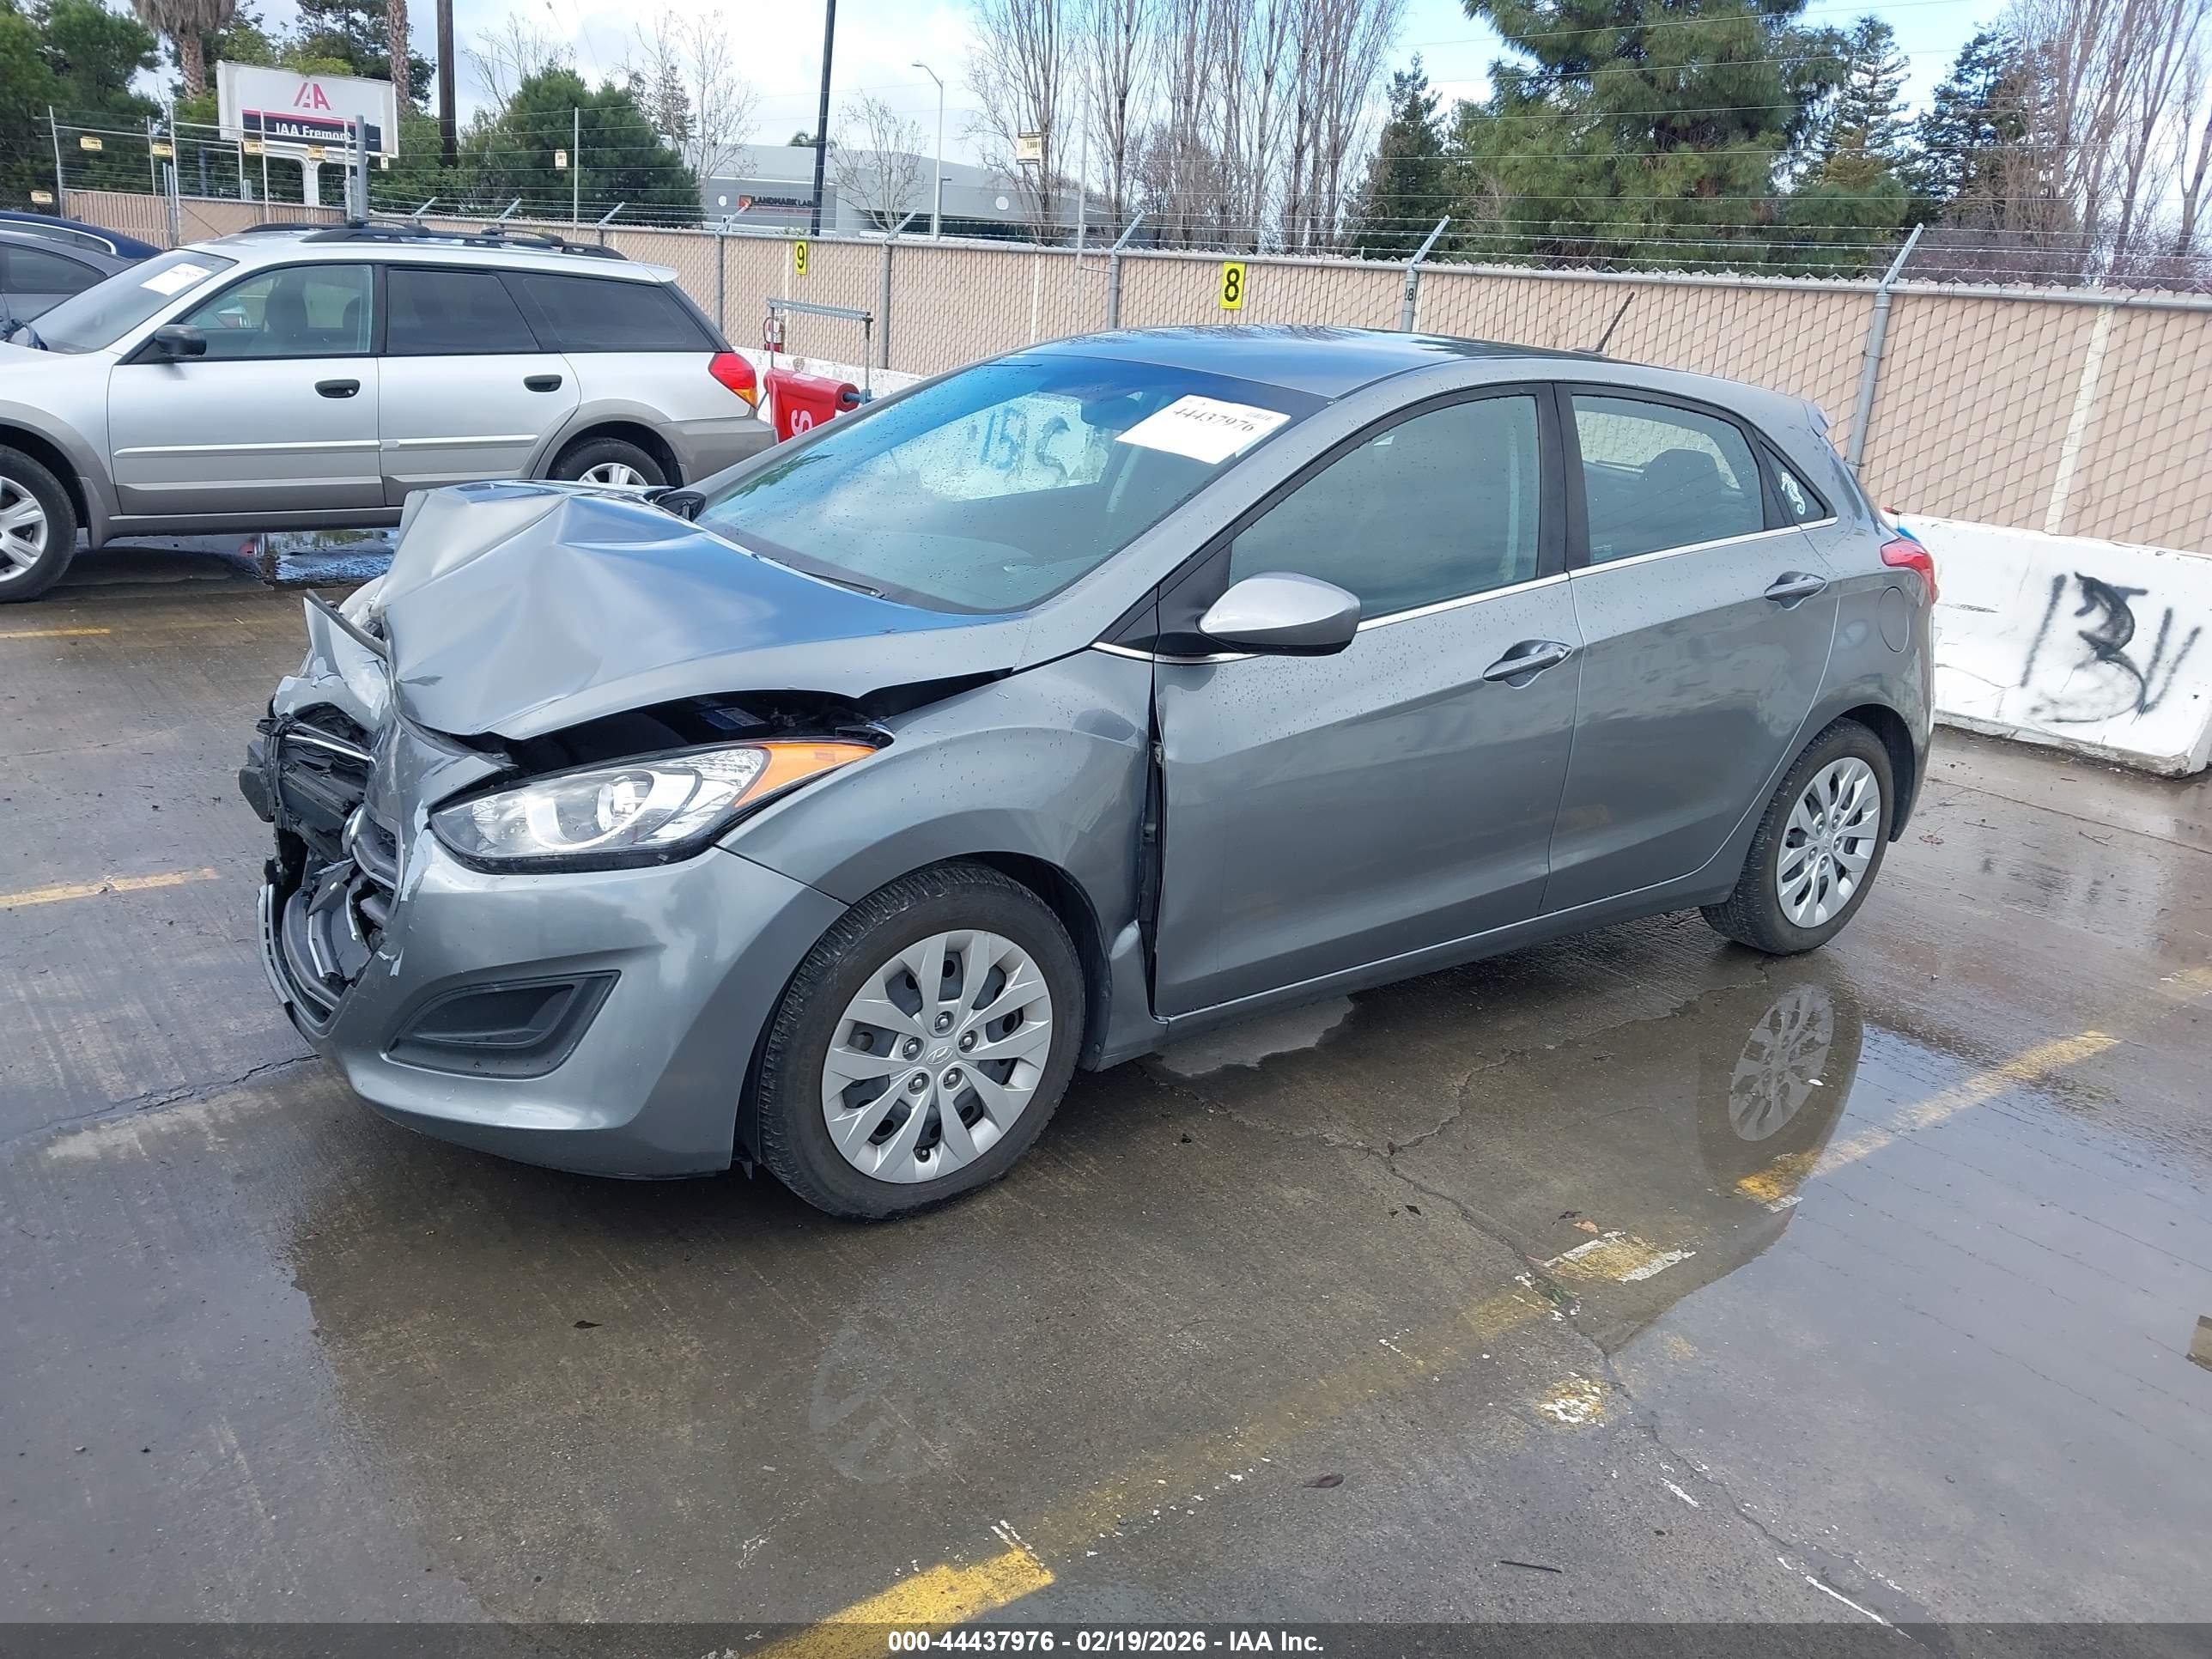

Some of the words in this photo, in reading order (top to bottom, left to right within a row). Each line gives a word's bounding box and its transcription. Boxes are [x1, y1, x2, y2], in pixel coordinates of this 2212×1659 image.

[276, 122, 300, 136] IAA
[302, 125, 350, 142] Fremon
[797, 244, 805, 270] 9
[1224, 267, 1240, 303] 8
[1173, 408, 1255, 432] 44437976
